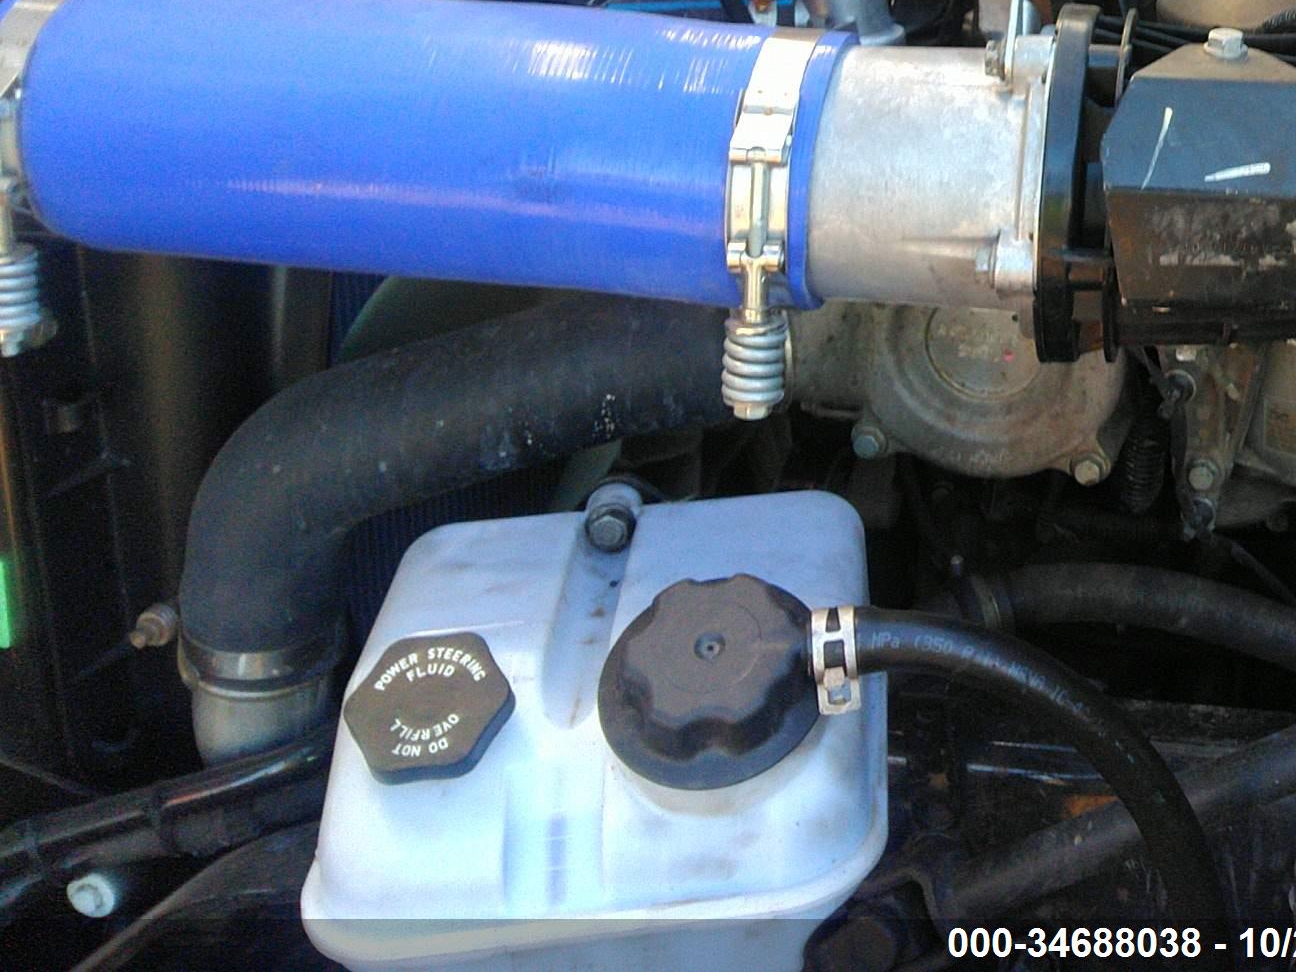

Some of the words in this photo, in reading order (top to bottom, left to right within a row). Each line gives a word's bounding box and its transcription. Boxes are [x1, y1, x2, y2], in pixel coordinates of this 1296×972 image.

[373, 652, 419, 691] POWER
[427, 647, 486, 682] STEERING
[405, 663, 455, 682] FLUID
[389, 713, 460, 742] OVERFILL
[391, 743, 422, 757] NOT
[428, 737, 449, 754] DO
